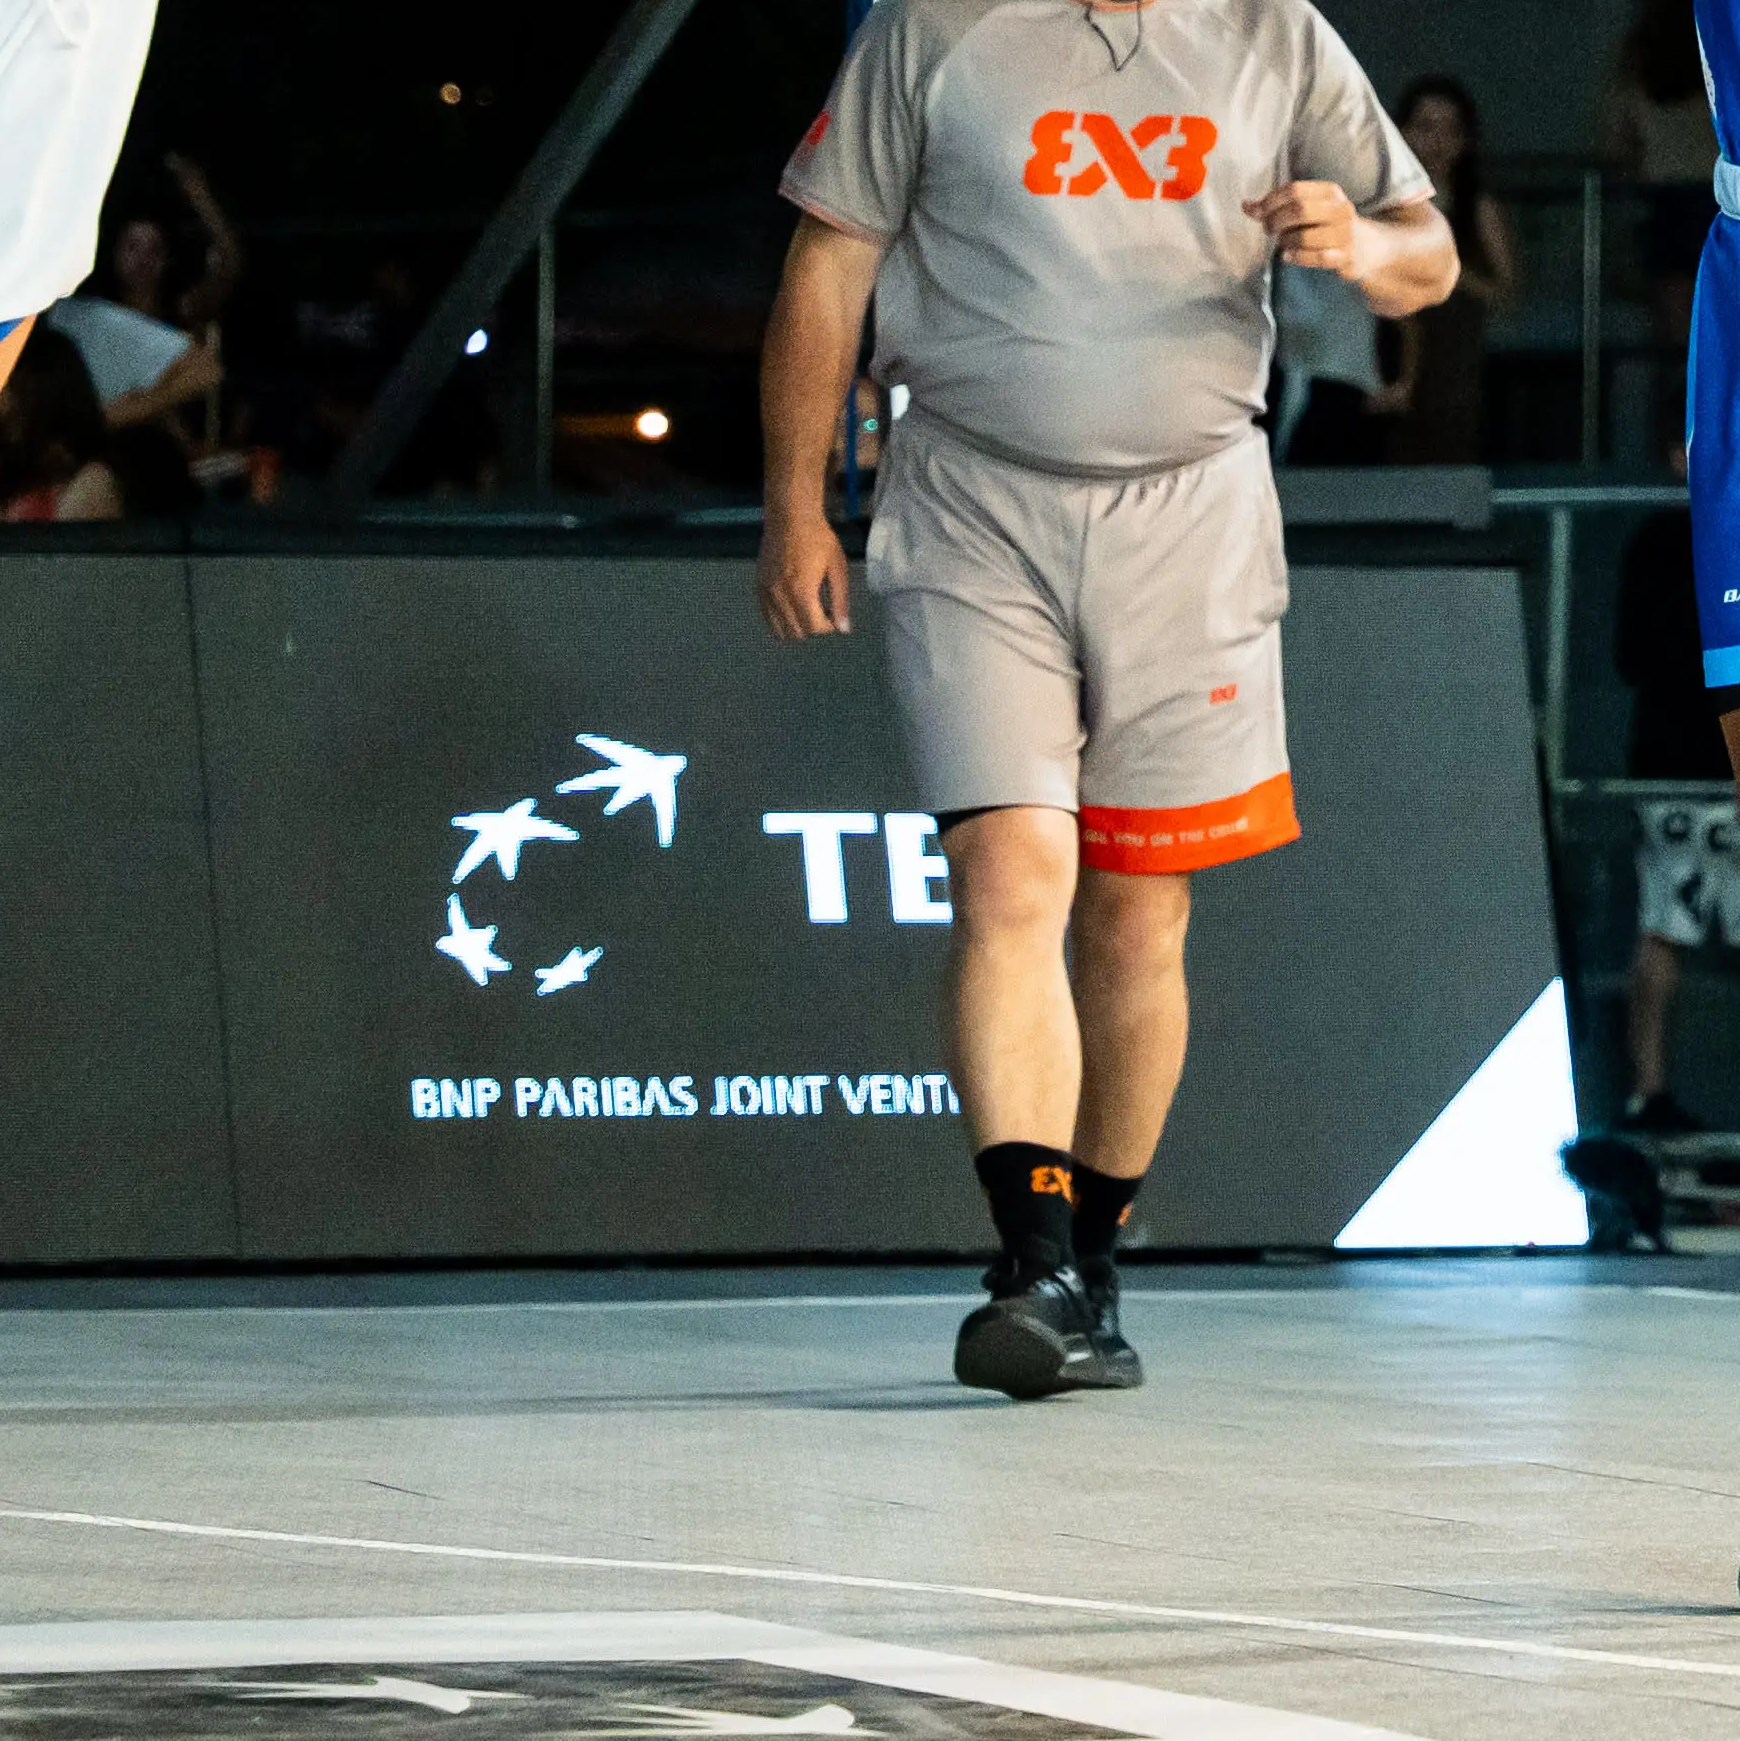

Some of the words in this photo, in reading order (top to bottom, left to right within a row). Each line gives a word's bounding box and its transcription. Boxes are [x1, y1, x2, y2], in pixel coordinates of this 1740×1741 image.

[762, 811, 954, 925] TE
[411, 1077, 502, 1118] BNP
[514, 1076, 699, 1118] PARIBAS
[709, 1075, 831, 1116] JOINT
[838, 1074, 961, 1116] VENT
